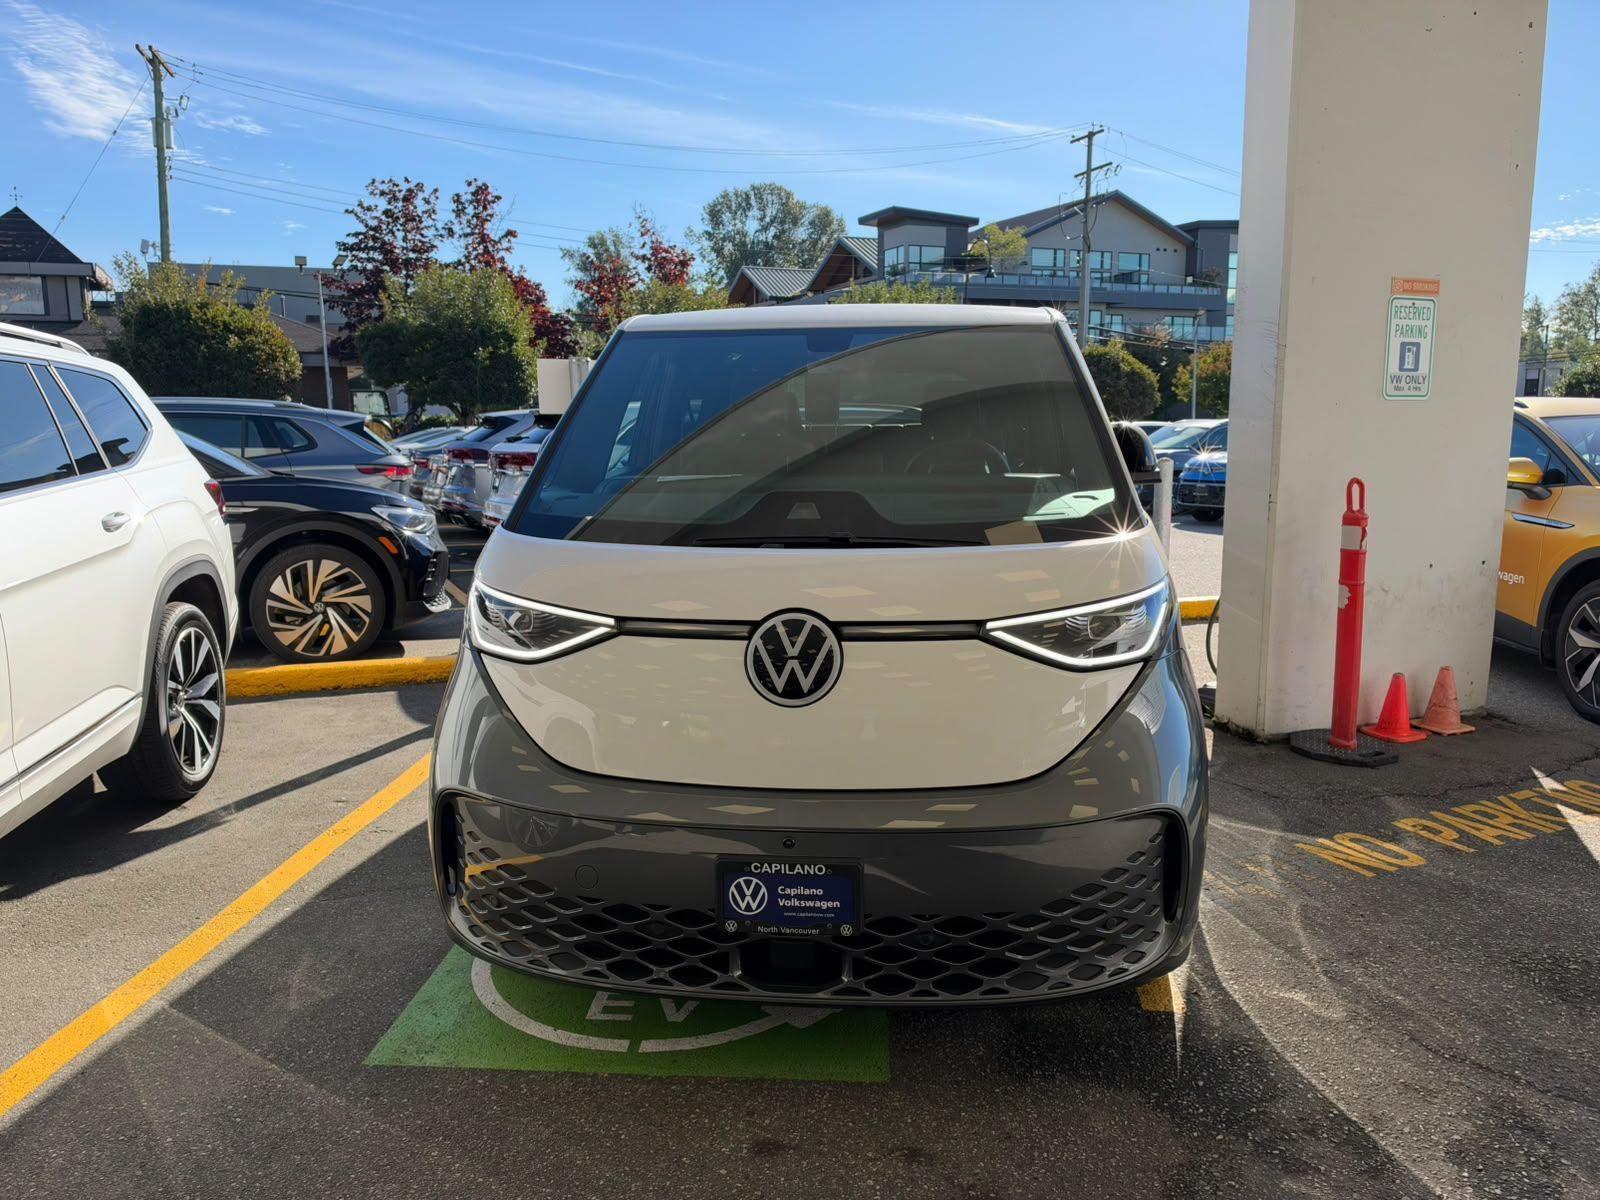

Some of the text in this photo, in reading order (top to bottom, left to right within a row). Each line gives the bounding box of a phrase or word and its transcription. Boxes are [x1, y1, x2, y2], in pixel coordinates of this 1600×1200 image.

[1393, 304, 1431, 321] RESERVED
[1394, 323, 1428, 339] PARKING
[1390, 375, 1427, 385] VW ONLY
[749, 613, 838, 699] VW
[1295, 831, 1428, 878] NO
[750, 862, 826, 875] CAPILANO
[730, 877, 767, 913] VW
[777, 885, 824, 897] Capilano
[777, 897, 841, 909] Volkswagen
[757, 925, 820, 935] North Vancouver
[585, 990, 701, 1022] EV
